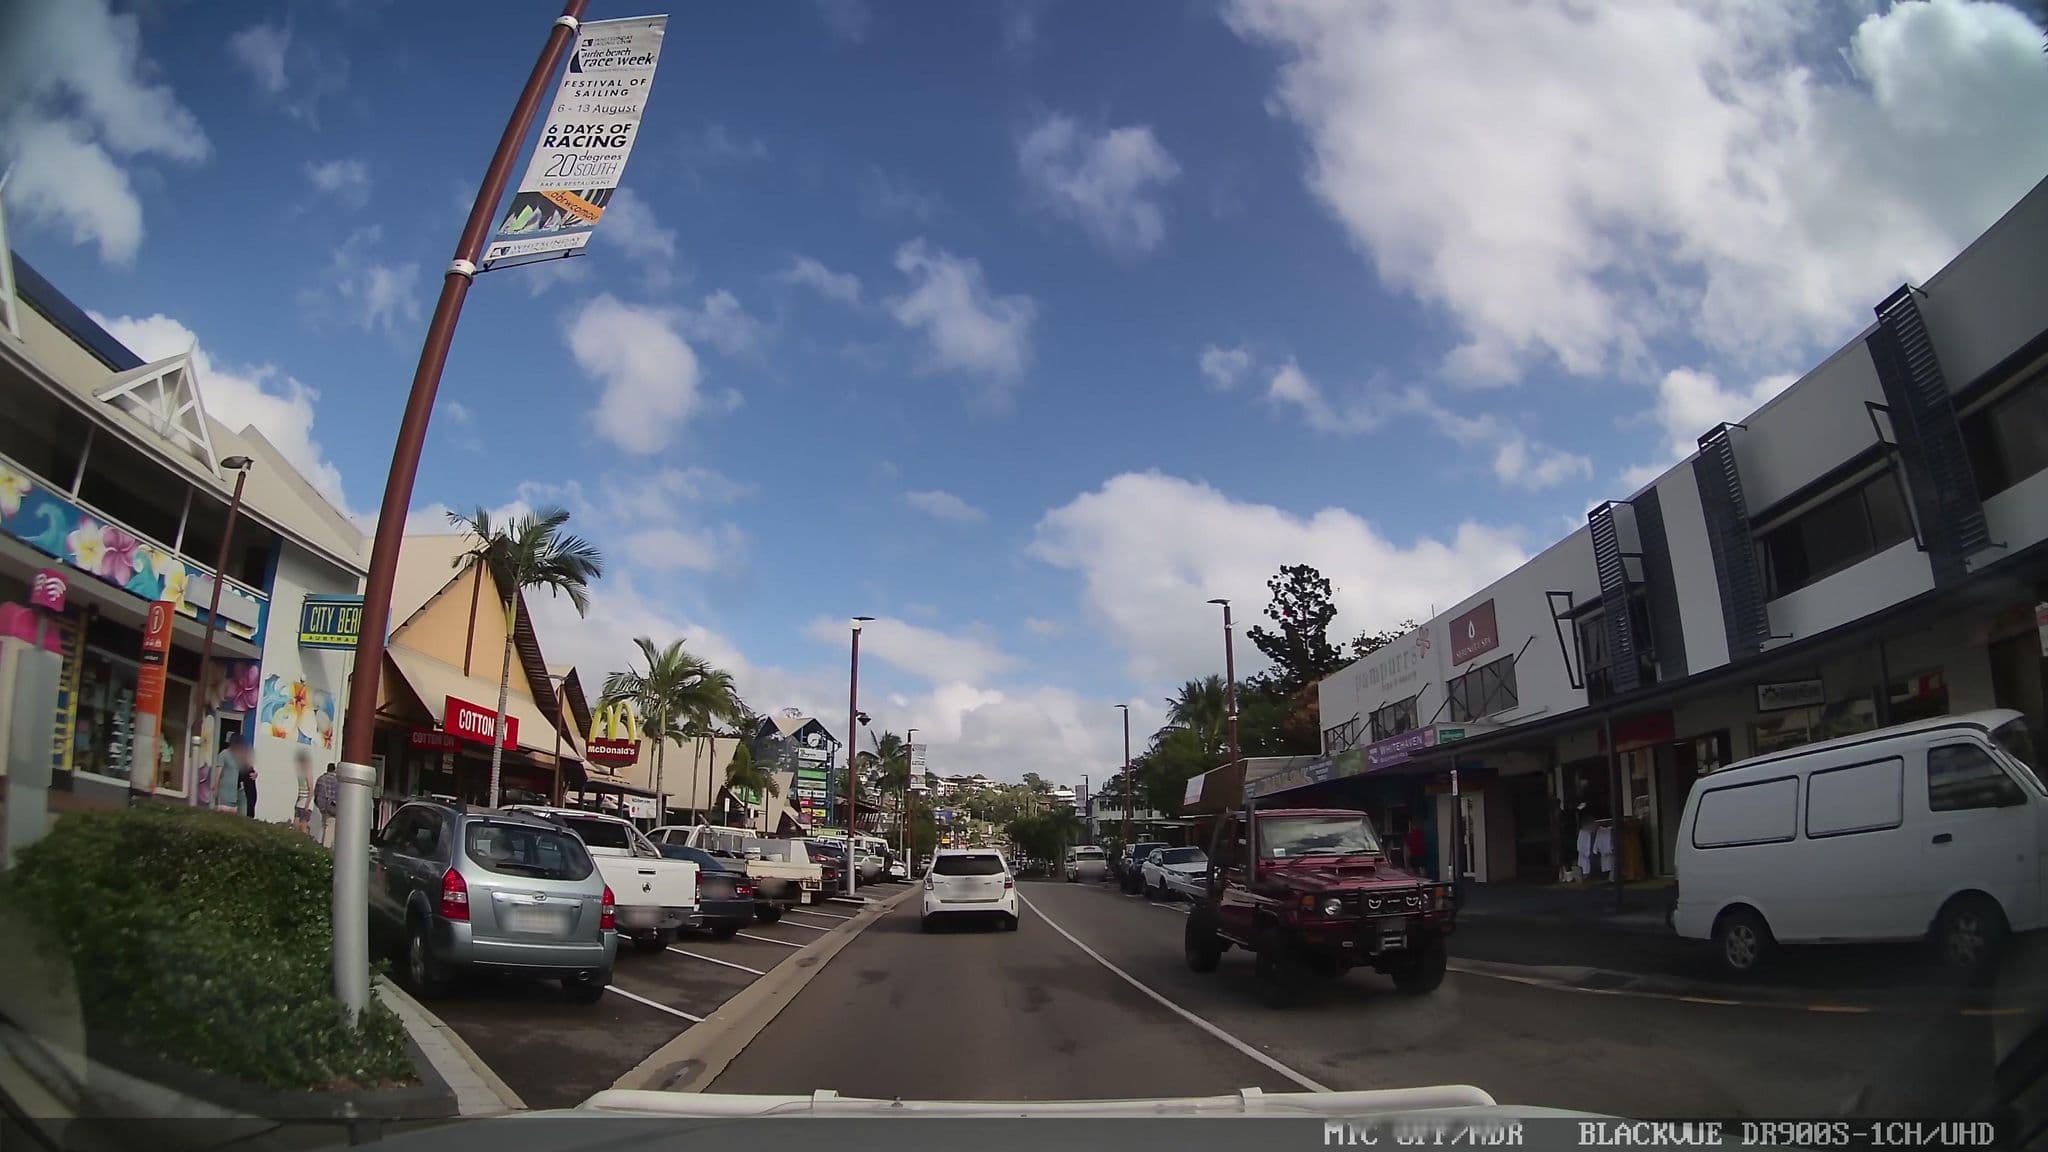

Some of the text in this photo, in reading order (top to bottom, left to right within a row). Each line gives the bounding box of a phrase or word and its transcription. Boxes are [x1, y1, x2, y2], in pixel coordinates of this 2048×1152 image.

[605, 47, 632, 57] beach
[583, 52, 655, 67] race week
[564, 78, 647, 88] FESTIVAL OF
[574, 89, 629, 98] SAILING
[557, 104, 566, 113] 6
[578, 104, 591, 113] 13
[592, 103, 637, 116] August
[548, 123, 632, 134] 6 DAYS OF
[543, 135, 627, 148] RACING
[544, 150, 622, 177] 20 degrees
[574, 162, 618, 177] SOUTH
[310, 606, 335, 633] CITY
[308, 635, 357, 643] AUSTRAL
[459, 708, 495, 738] COTTON
[412, 731, 442, 746] COTTON
[587, 744, 635, 755] McDonald's
